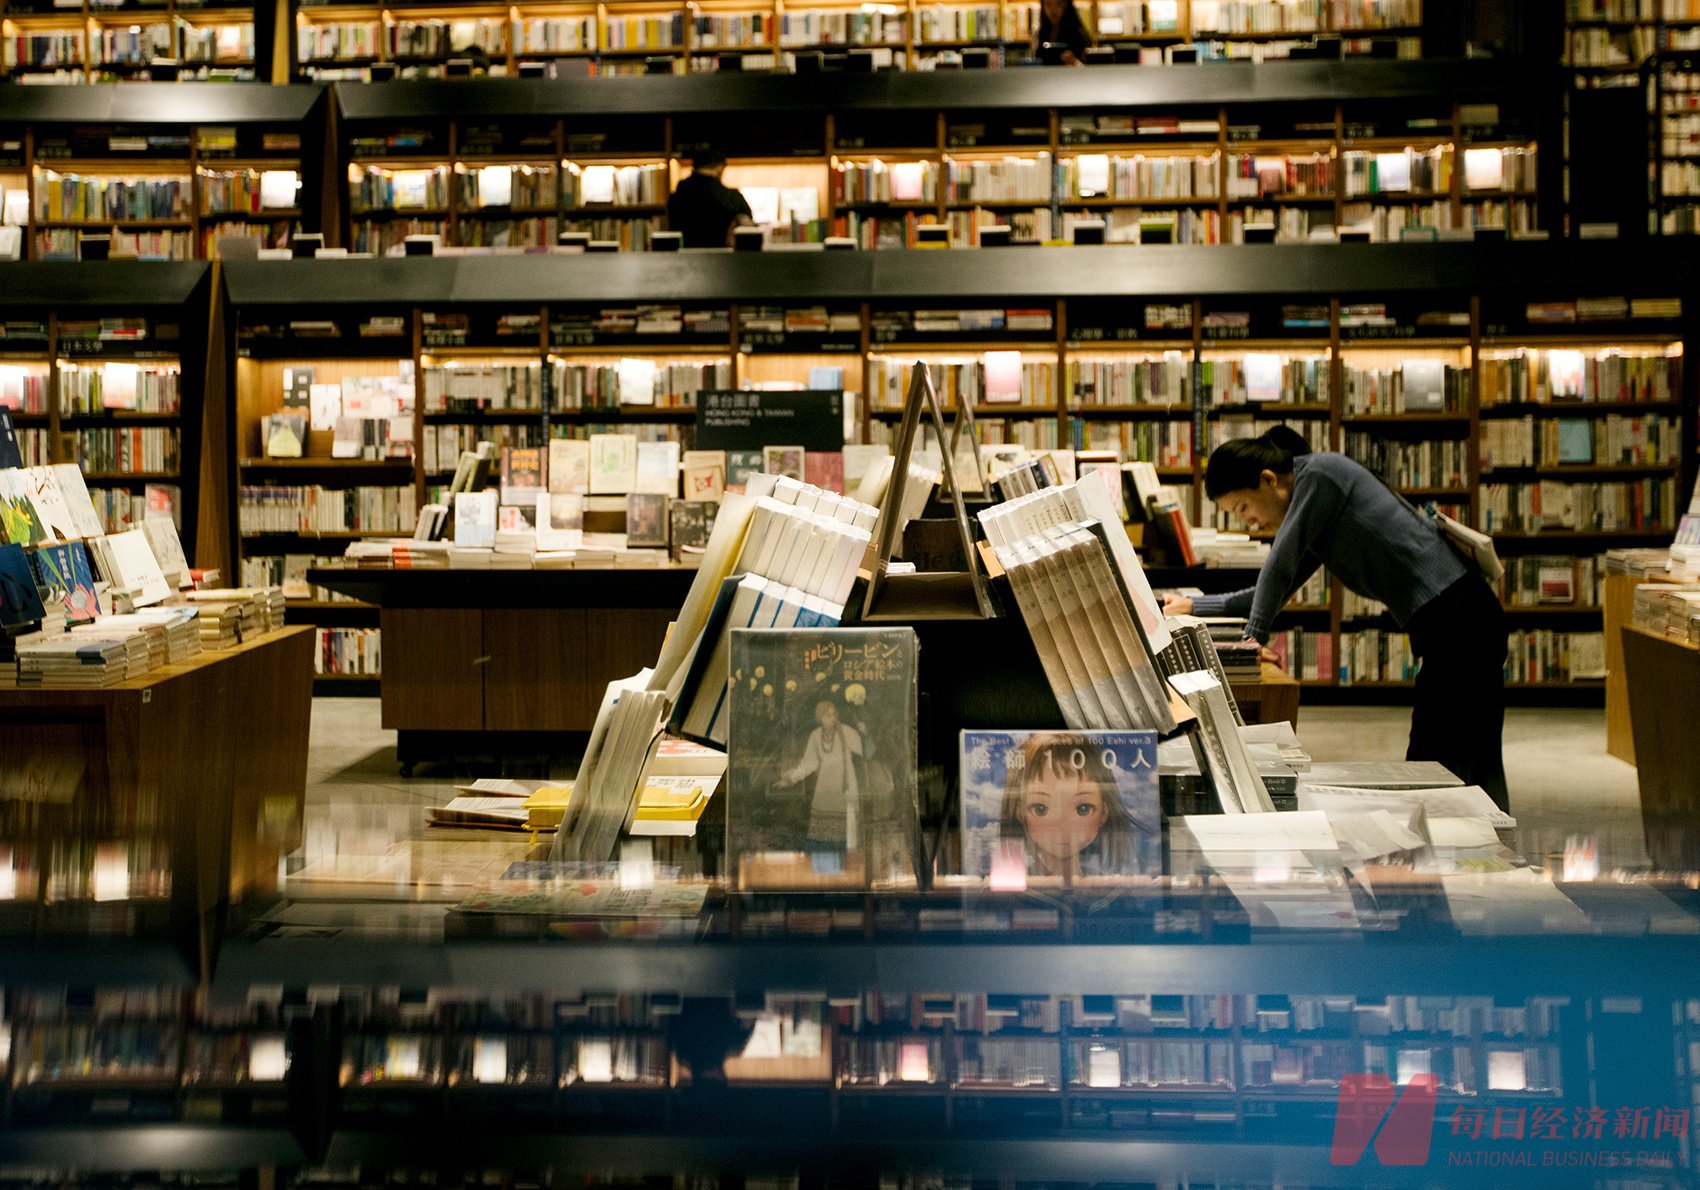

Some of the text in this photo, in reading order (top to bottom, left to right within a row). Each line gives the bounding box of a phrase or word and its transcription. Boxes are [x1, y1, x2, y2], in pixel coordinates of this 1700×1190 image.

[704, 409, 731, 418] HONG
[731, 409, 755, 418] KONG
[764, 408, 794, 417] TAIWAN
[704, 418, 751, 427] PUBLISHING
[971, 736, 987, 745] The
[991, 736, 1010, 745] Best
[1088, 736, 1105, 745] 100
